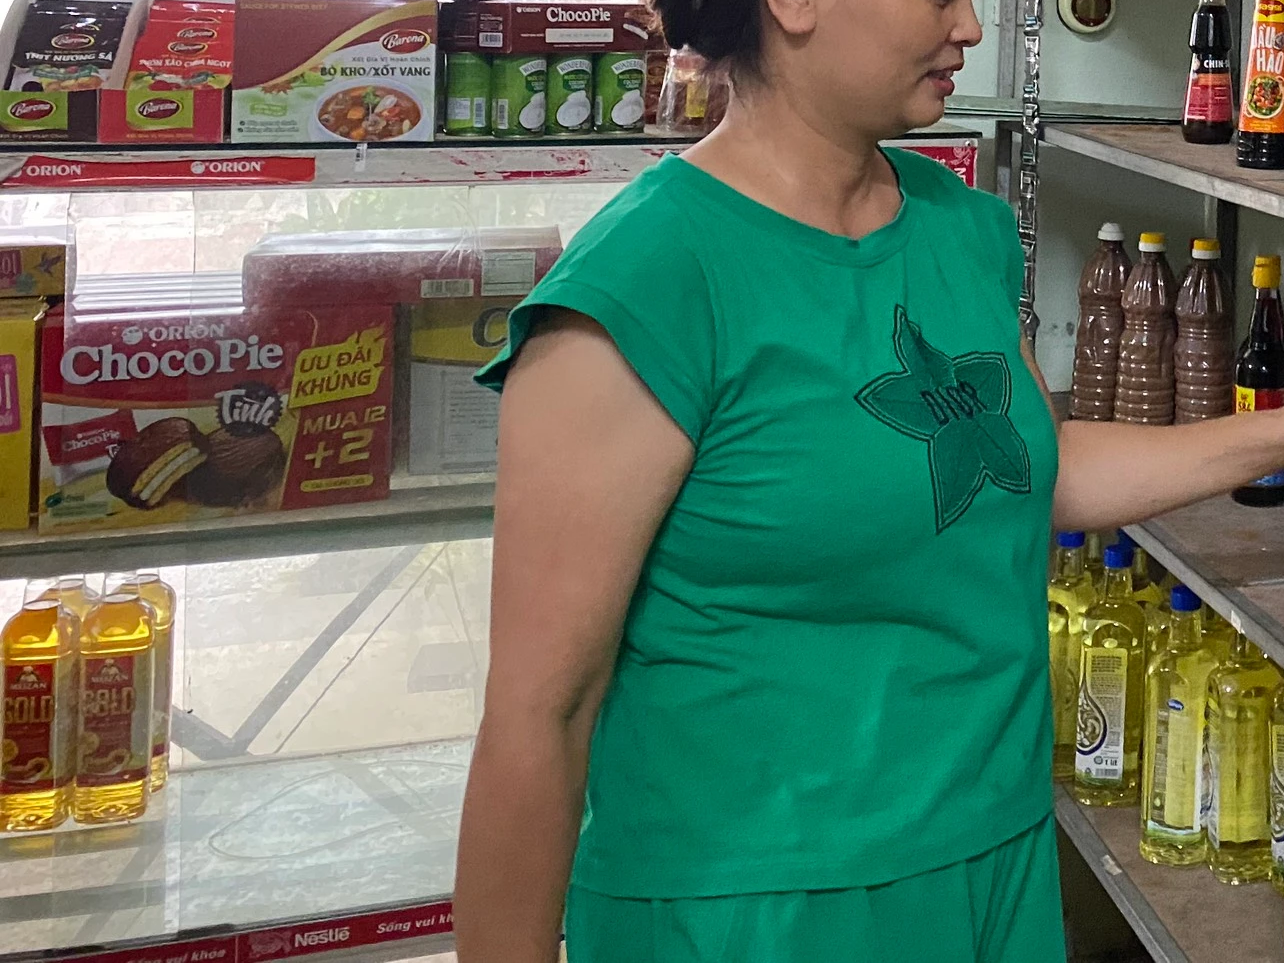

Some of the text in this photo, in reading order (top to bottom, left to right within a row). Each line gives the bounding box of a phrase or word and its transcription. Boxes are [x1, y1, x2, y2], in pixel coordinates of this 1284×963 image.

[546, 7, 611, 22] ChocoPie
[382, 34, 425, 49] Barona
[1257, 49, 1284, 74] HÀO
[321, 63, 337, 76] BÒ
[400, 66, 430, 76] VANG
[26, 165, 82, 176] ORION
[208, 161, 262, 174] ORION
[60, 333, 284, 385] ChocoPie
[303, 404, 387, 437] MUA 12
[415, 918, 436, 928] vui
